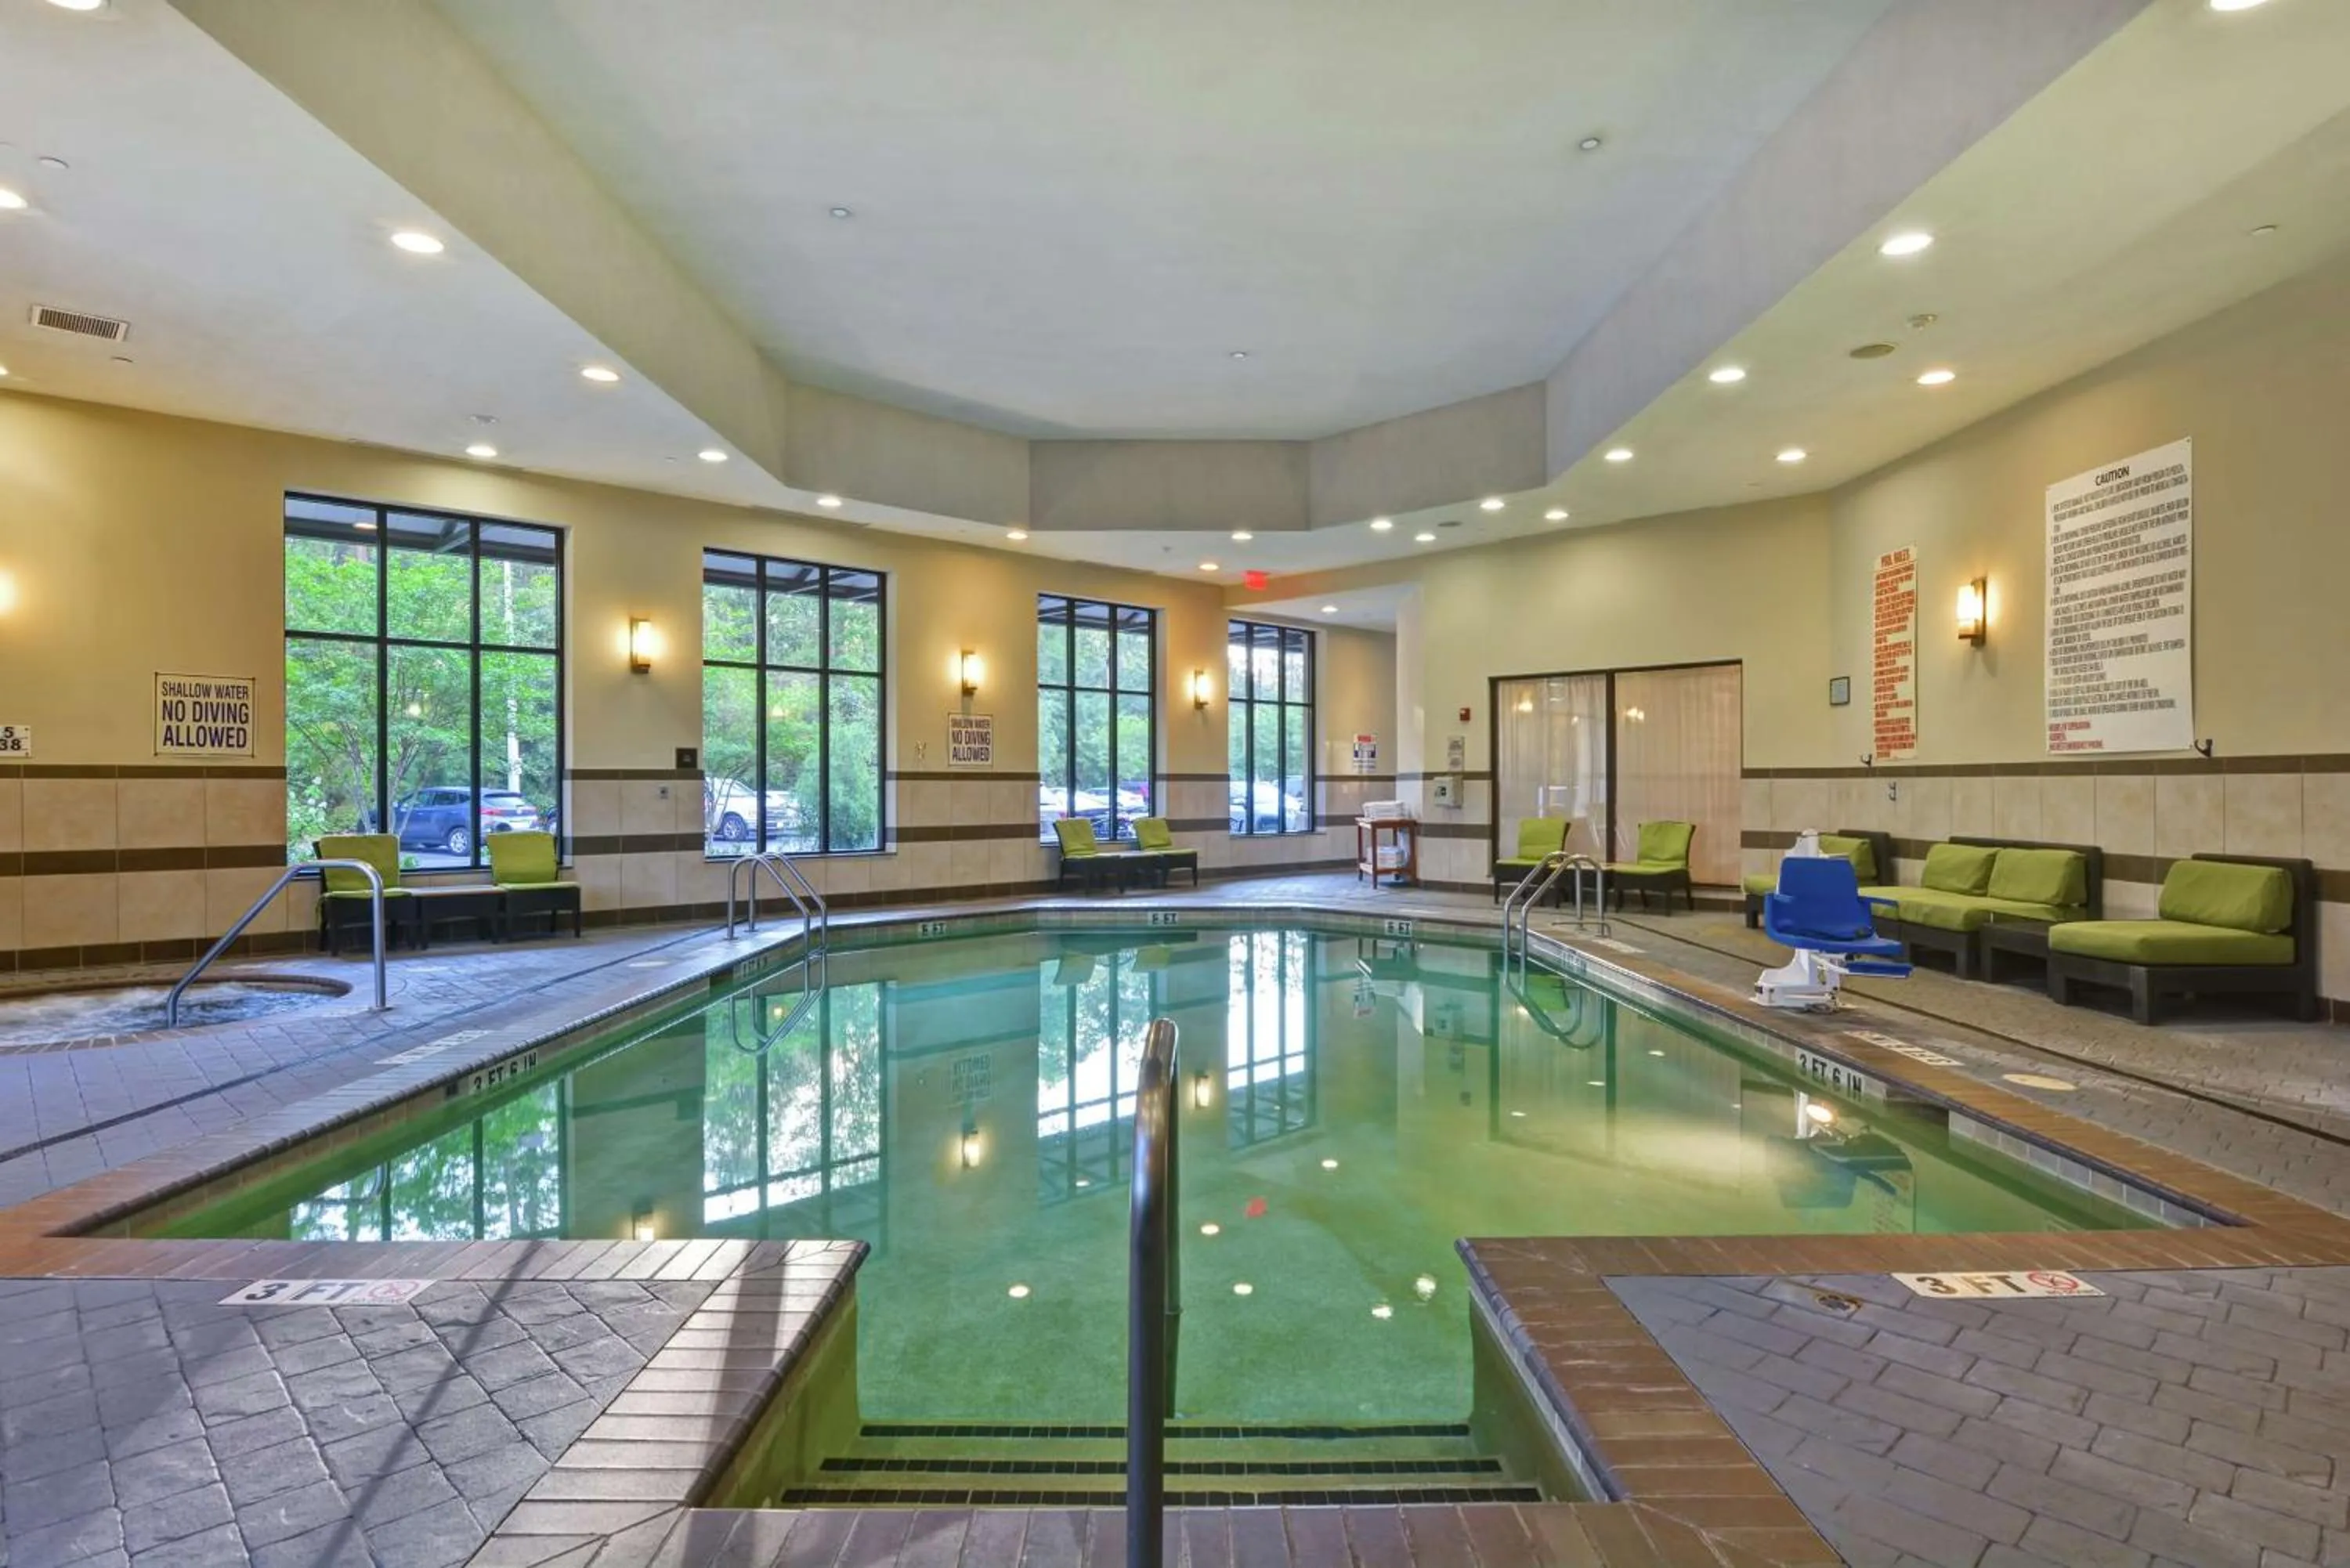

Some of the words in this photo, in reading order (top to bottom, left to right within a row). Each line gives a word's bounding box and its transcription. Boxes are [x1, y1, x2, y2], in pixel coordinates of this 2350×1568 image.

[2095, 466, 2130, 486] CAUTION
[162, 681, 212, 699] SHALLOW
[214, 684, 248, 699] WATER
[162, 699, 186, 722] NO
[192, 700, 249, 724] DIVING
[163, 724, 247, 748] ALLOWED
[953, 729, 963, 745] NO
[965, 729, 990, 746] DIVING
[953, 746, 989, 761] ALLOWED
[1813, 1057, 1827, 1080] FT
[1833, 1068, 1841, 1084] 6
[1847, 1072, 1862, 1093] IN
[245, 1283, 288, 1300] 3
[289, 1283, 367, 1301] FT
[1916, 1276, 1958, 1294] 3
[1961, 1274, 2026, 1293] FT
